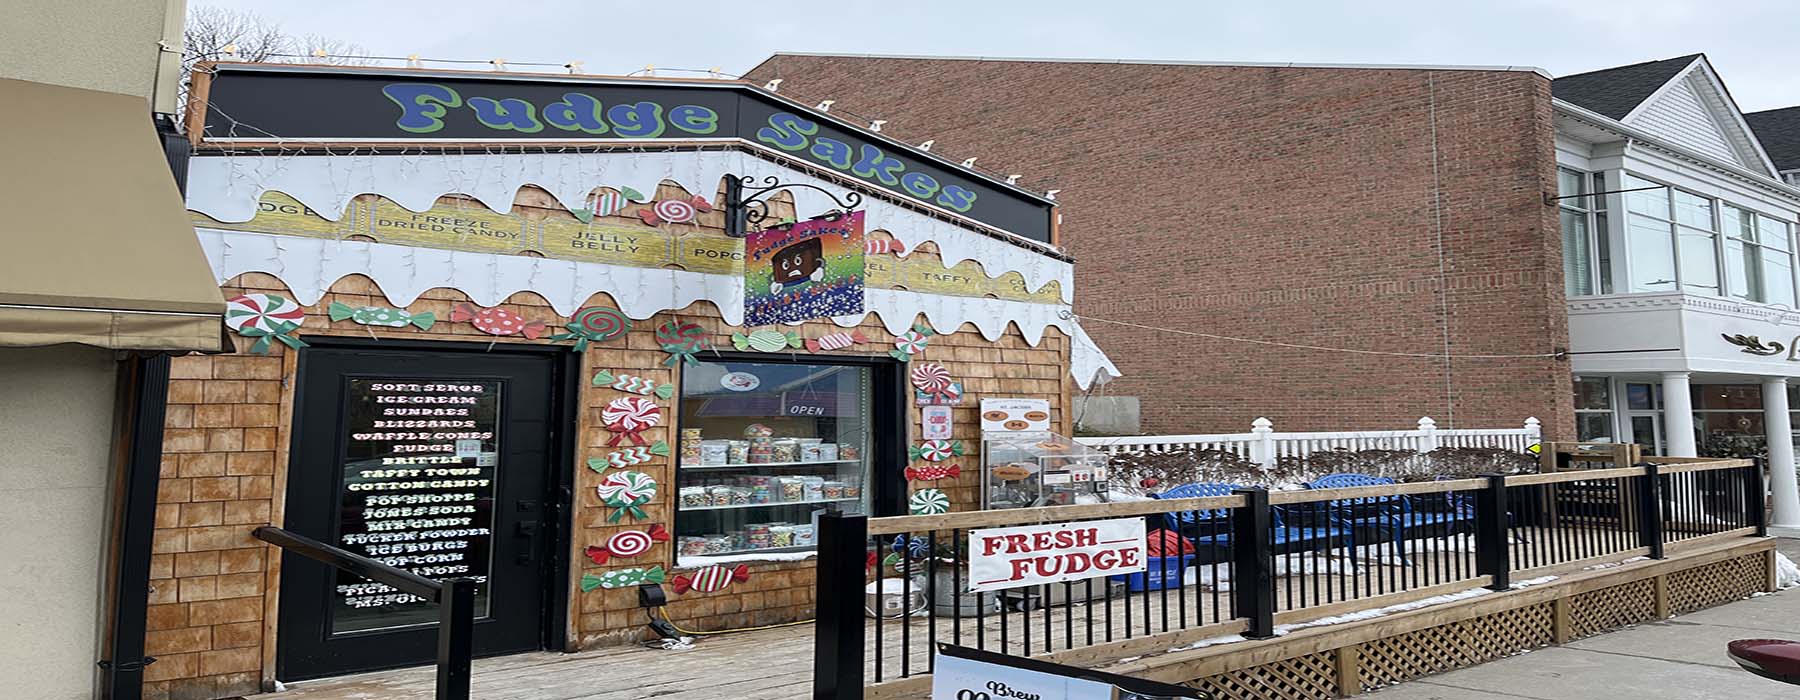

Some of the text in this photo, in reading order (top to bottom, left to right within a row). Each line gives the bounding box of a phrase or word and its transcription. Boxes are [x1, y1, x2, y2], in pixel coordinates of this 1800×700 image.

[382, 83, 977, 212] Fudge Sakes
[258, 202, 317, 216] DGE
[412, 215, 491, 228] FREEZE
[378, 219, 519, 239] DRIED CANDY
[573, 231, 638, 244] JELLY
[753, 227, 849, 260] Fudge Sakes
[571, 241, 640, 254] BELLY
[694, 249, 745, 261] POPC
[921, 272, 971, 284] TAFFY
[371, 383, 423, 391] SOFT
[376, 396, 477, 404] ICE CREAM
[383, 408, 469, 416] SUNDAES
[789, 405, 825, 415] OPEN
[374, 420, 476, 428] BLIZZARDS
[352, 432, 493, 441] WAFFLE CONES
[393, 444, 454, 452] FUDGE
[382, 456, 462, 465] BRITTLE
[360, 468, 480, 478] TAFFY TOWN
[348, 480, 490, 491] COTTON CANDY
[365, 493, 476, 506] POP SHOPPE
[363, 505, 476, 519] JONES SODA
[367, 517, 472, 532] MIX CANDY
[418, 528, 491, 539] POWDER
[369, 541, 468, 555] ICE BURGS
[982, 528, 1098, 556] FRESH
[413, 553, 464, 564] CORN
[1009, 547, 1140, 581] FUDGE
[986, 680, 1042, 700] Brew
